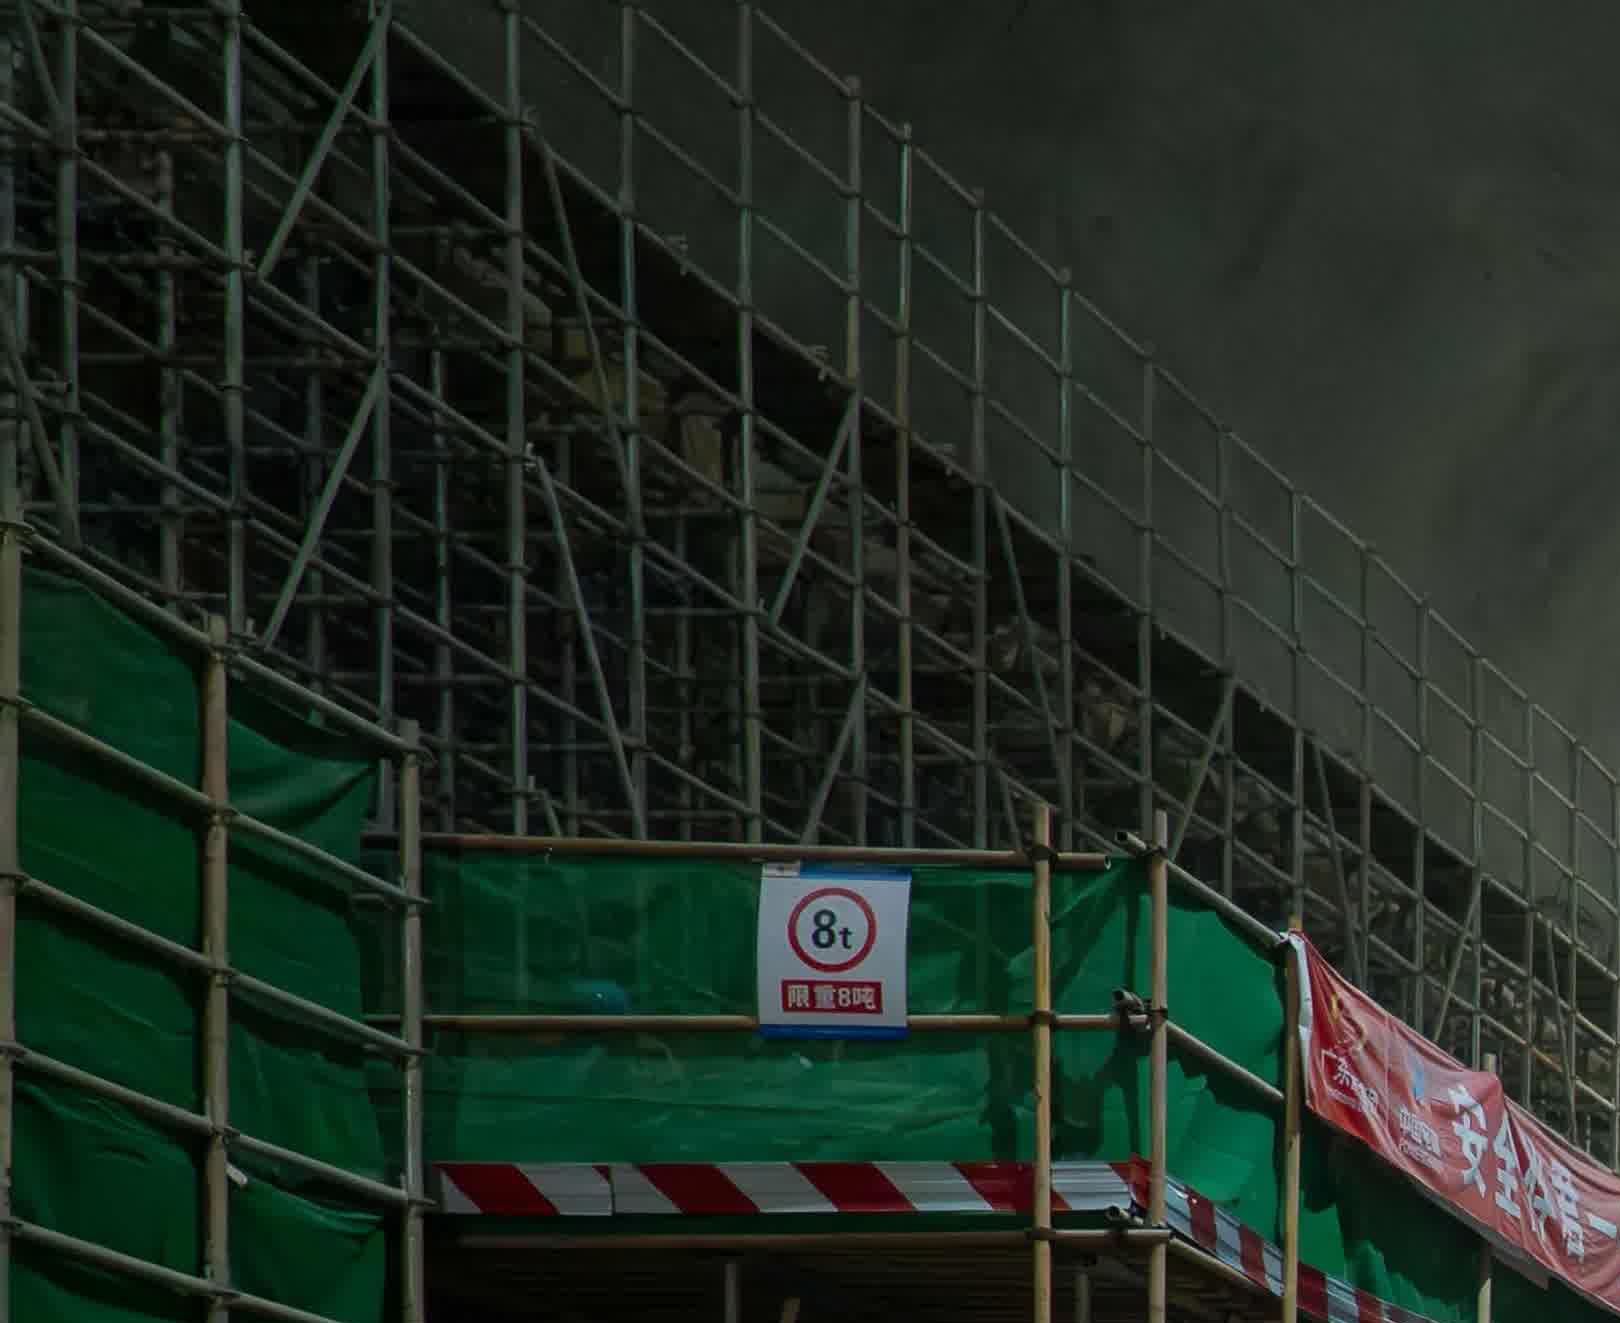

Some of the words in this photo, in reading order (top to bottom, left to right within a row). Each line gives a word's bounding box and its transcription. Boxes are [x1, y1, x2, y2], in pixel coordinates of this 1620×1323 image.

[811, 908, 854, 950] 8t
[787, 984, 877, 1010] 限重8吨
